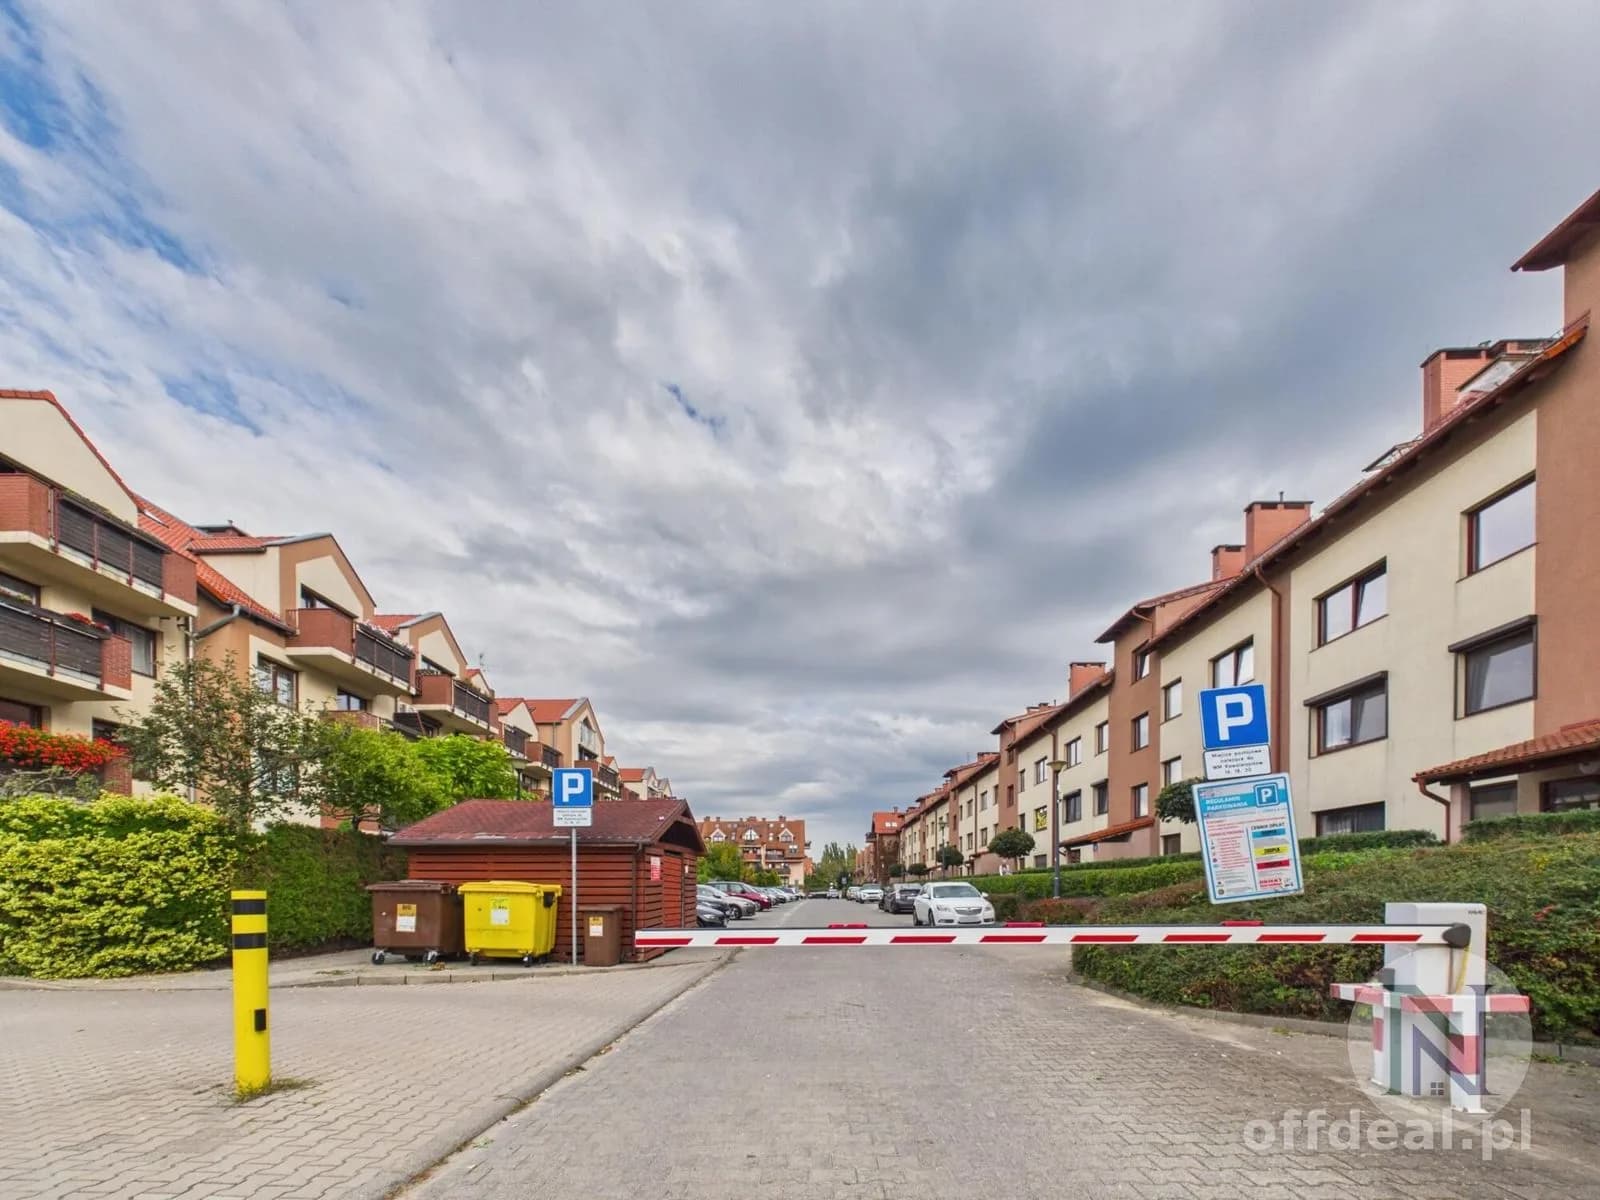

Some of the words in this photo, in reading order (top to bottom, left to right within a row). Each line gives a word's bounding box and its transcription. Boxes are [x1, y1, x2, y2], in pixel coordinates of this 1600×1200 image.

[1215, 692, 1254, 741] P
[562, 772, 584, 802] P
[1260, 788, 1273, 803] P
